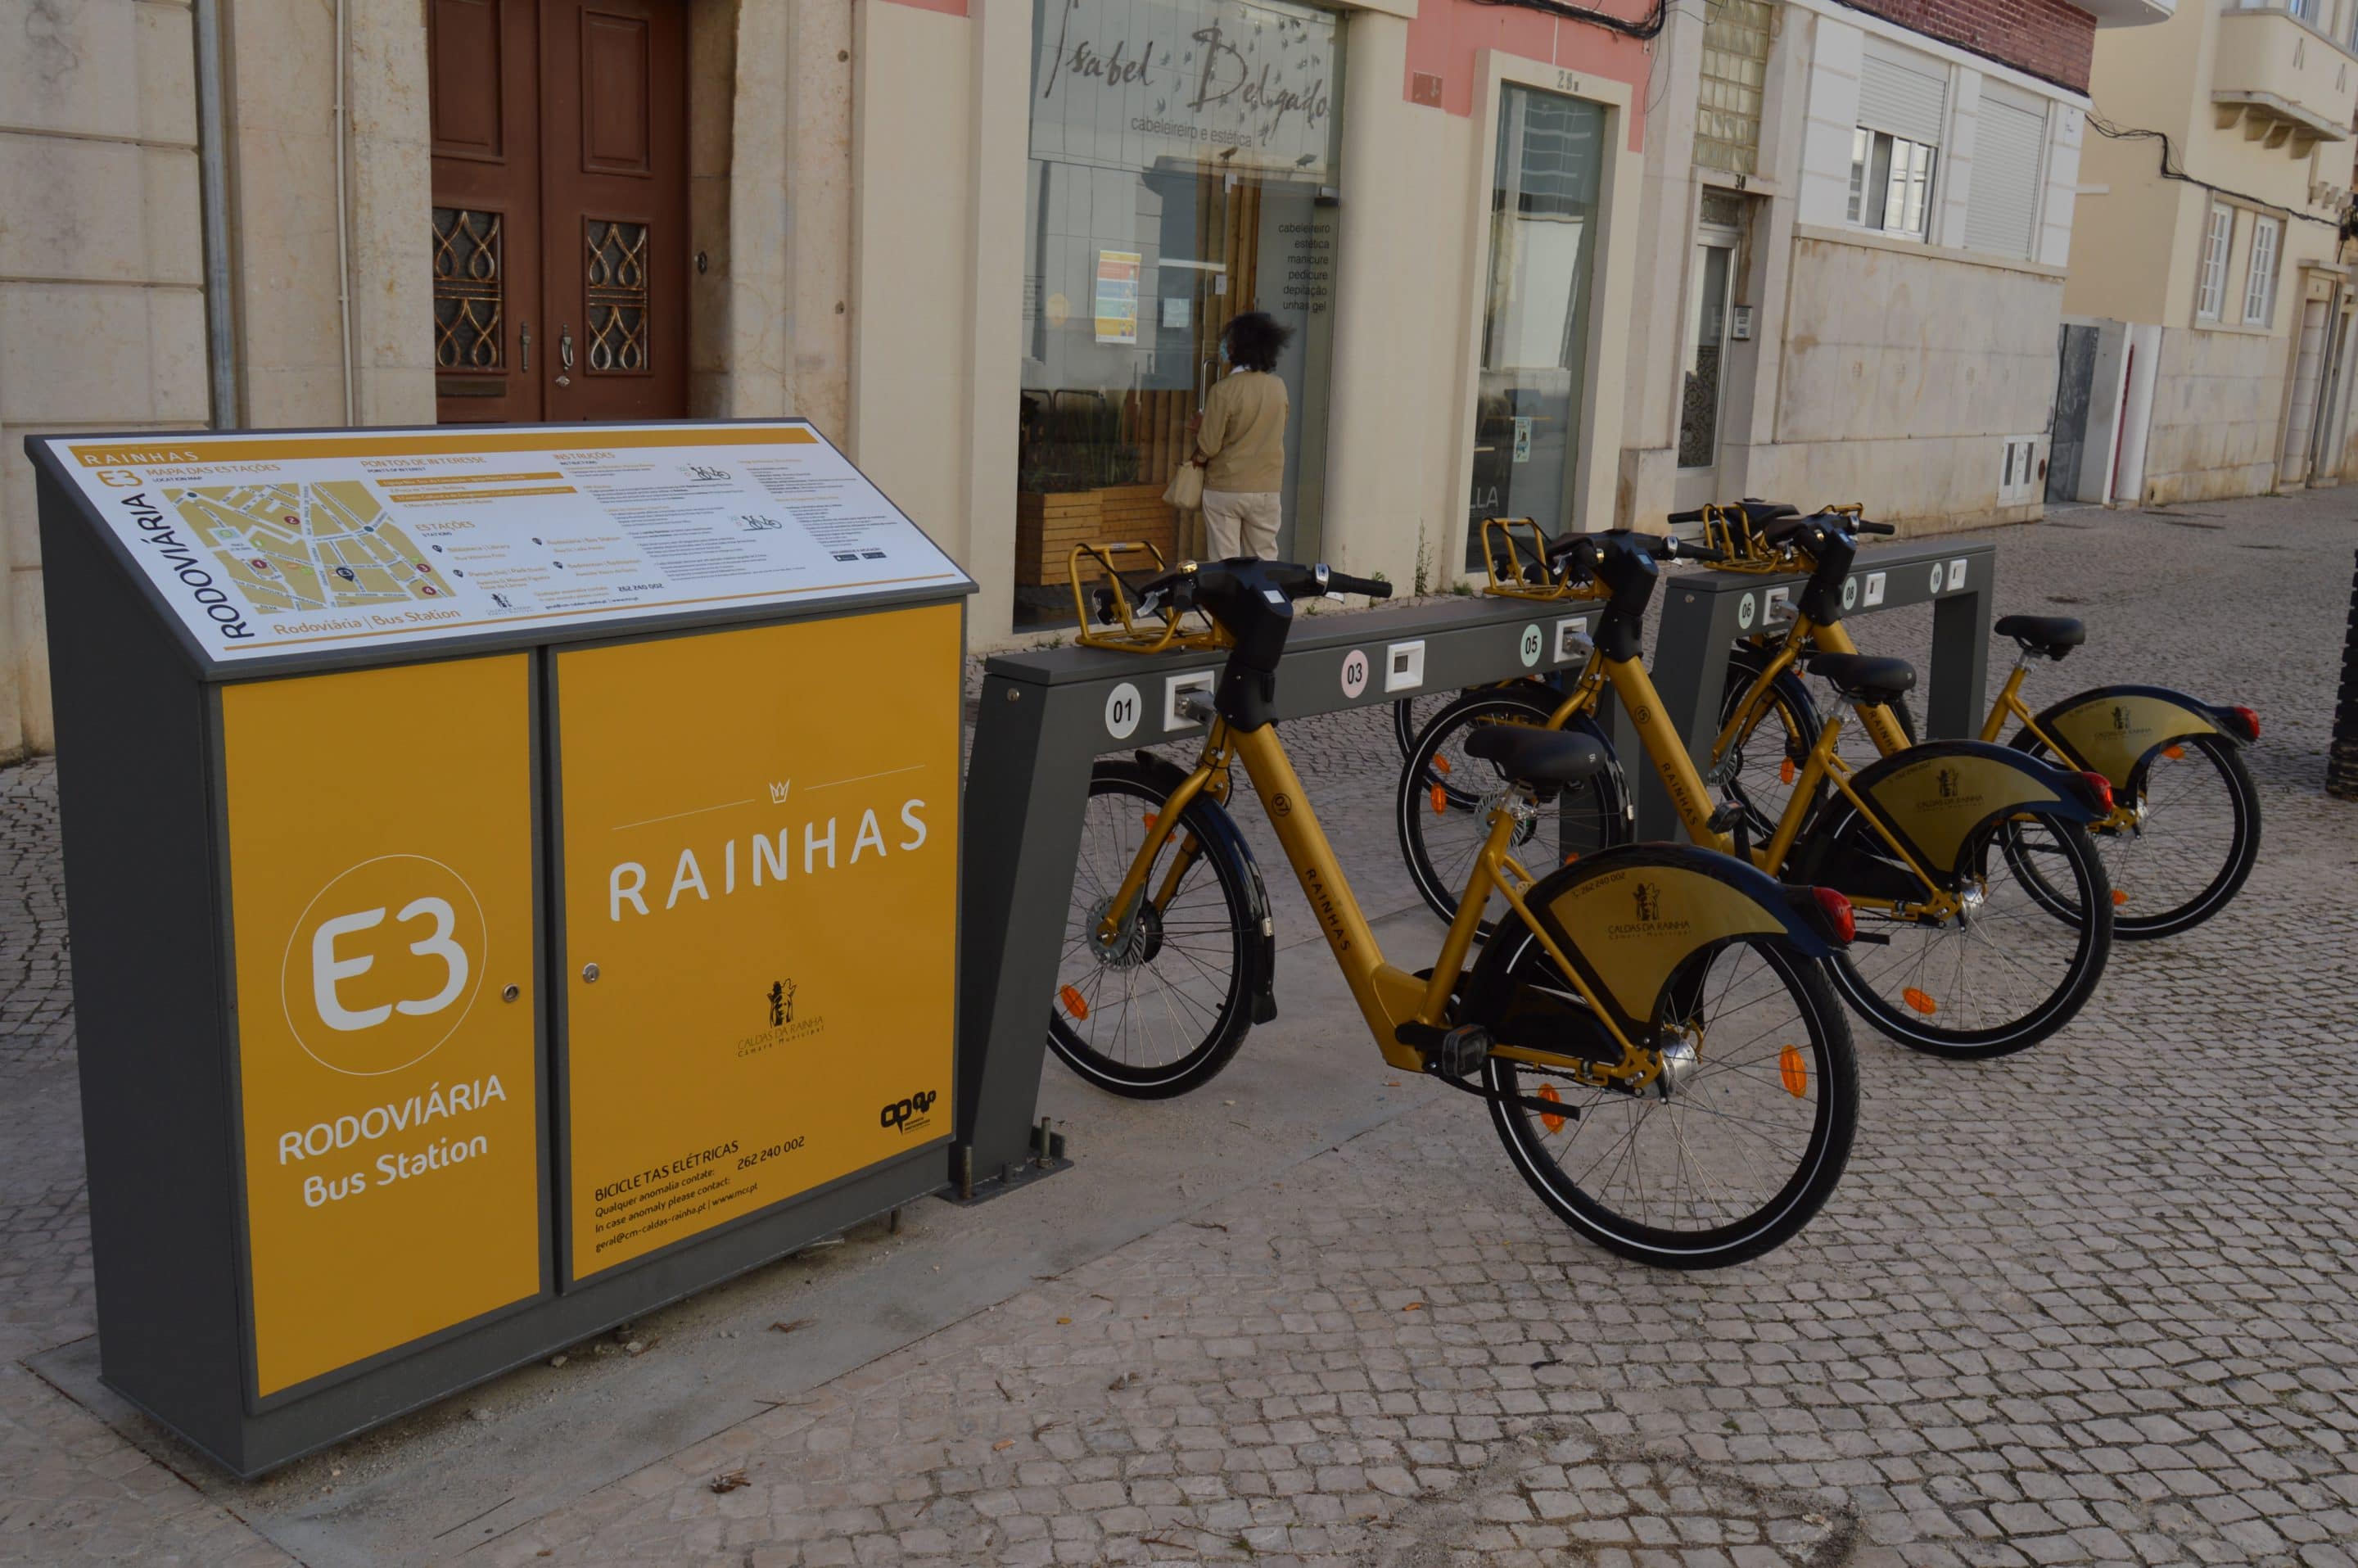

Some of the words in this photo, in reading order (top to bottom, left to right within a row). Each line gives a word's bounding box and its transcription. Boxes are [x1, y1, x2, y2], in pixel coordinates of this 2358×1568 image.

[1044, 0, 1154, 98] Isabel
[1187, 26, 1330, 147] Delgado
[1131, 115, 1199, 140] cabeleireiro
[1200, 130, 1208, 141] e
[1210, 127, 1253, 147] estética
[1278, 222, 1330, 234] cabeleireiro
[1294, 238, 1330, 250] estética
[1287, 254, 1329, 264] manicure
[1288, 269, 1328, 282] pedicure
[1283, 285, 1327, 299] depilação
[1283, 300, 1307, 310] unhas
[1308, 300, 1326, 313] gel
[84, 451, 199, 465] RAINHAS
[147, 468, 184, 477] MAPA
[186, 466, 213, 475] DAS
[214, 463, 281, 473] ESTAÇÕES
[361, 459, 411, 468] PONTOS
[412, 458, 426, 466] DE
[427, 456, 486, 466] INTERESSE
[97, 470, 142, 487] E3
[414, 520, 476, 531] ESTAÇÕES
[120, 492, 255, 639] RODOVIÁRIA
[1845, 585, 1855, 601] 08
[273, 613, 364, 636] Rodoviária
[371, 611, 402, 629] Bus
[404, 607, 462, 625] Station
[1741, 602, 1752, 619] 06
[1525, 635, 1538, 653] 05
[1347, 662, 1363, 685] 03
[1113, 698, 1132, 724] 01
[1662, 762, 1698, 826] RAINHAS
[610, 799, 927, 922] RAINHAS
[1306, 868, 1351, 951] RAINHAS
[1607, 924, 1642, 934] CALDAS
[1642, 923, 1654, 932] DA
[1657, 920, 1691, 931] RAINHA
[312, 897, 468, 1031] E3
[738, 1030, 773, 1050] CALDAS
[790, 1015, 824, 1034] RAINHA
[278, 1074, 506, 1165] RODOVIÁRIA
[737, 1153, 757, 1171] 262
[760, 1145, 781, 1162] 240
[784, 1136, 805, 1153] 002
[304, 1172, 366, 1208] Bus
[376, 1135, 488, 1186] Station
[595, 1164, 670, 1201] BICICLETAS
[672, 1141, 739, 1173] ELÉTRICAS
[595, 1197, 637, 1218] Qualquer
[639, 1182, 680, 1202] anomalia
[681, 1168, 715, 1186] contate:
[595, 1224, 604, 1233] In
[606, 1218, 626, 1229] case
[628, 1201, 666, 1222] anomaly
[667, 1191, 696, 1209] please
[697, 1177, 730, 1195] contact:
